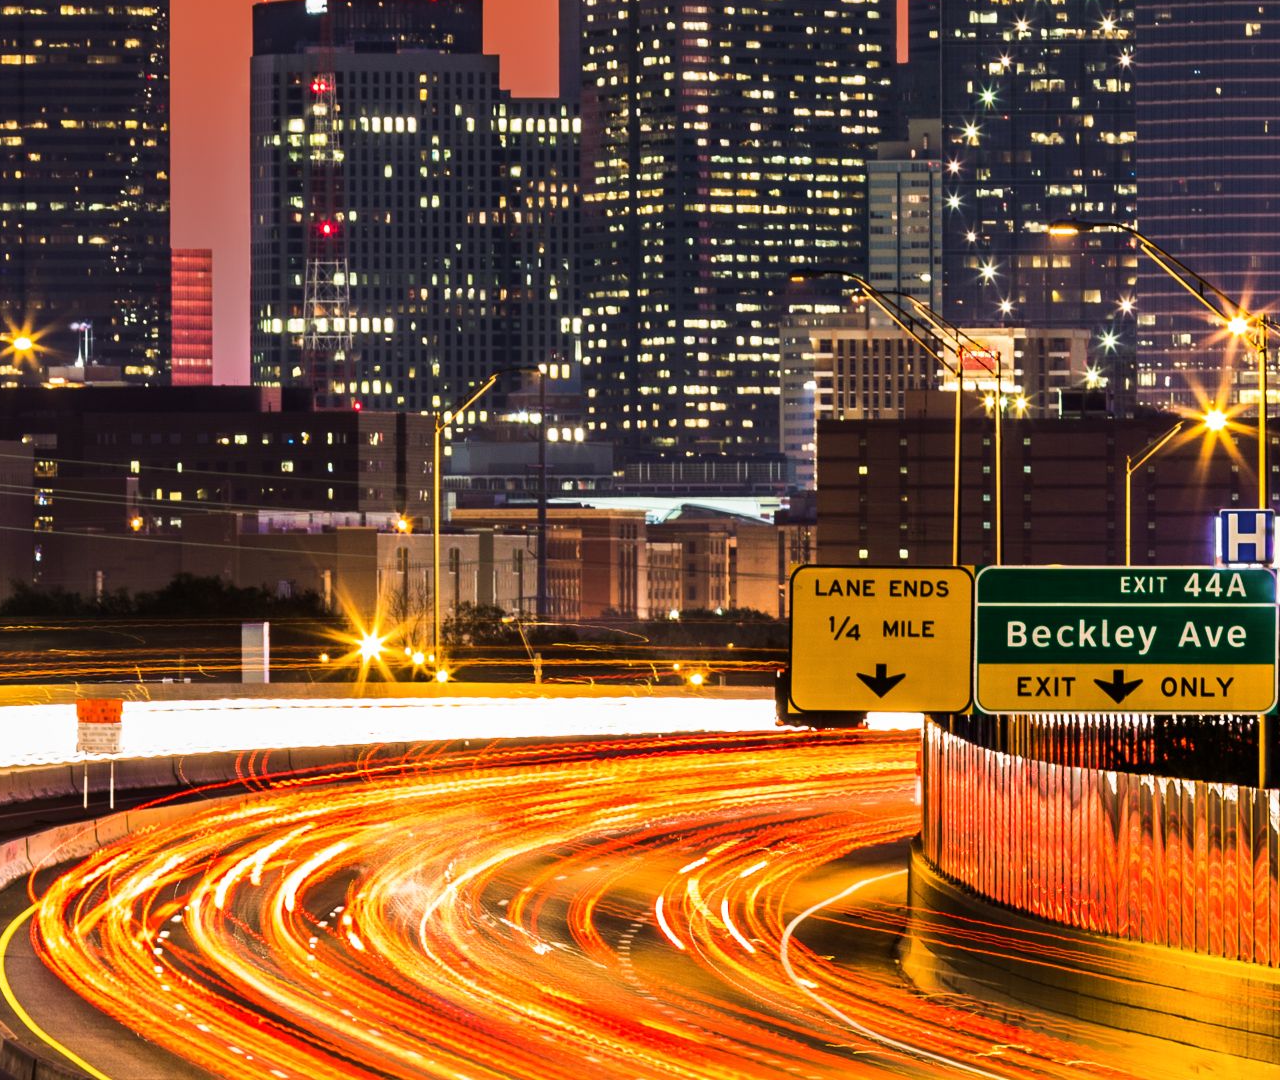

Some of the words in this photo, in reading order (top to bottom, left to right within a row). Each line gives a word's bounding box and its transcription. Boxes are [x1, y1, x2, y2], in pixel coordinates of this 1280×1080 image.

[1227, 513, 1266, 562] H
[815, 579, 875, 597] LANE
[889, 580, 950, 598] ENDS
[1120, 576, 1168, 594] EXIT
[1183, 573, 1247, 598] 44A
[882, 620, 935, 638] MILE
[1006, 619, 1157, 655] Beckley
[1177, 621, 1247, 648] Ave
[1017, 676, 1076, 697] EXIT
[1160, 676, 1235, 697] ONLY
